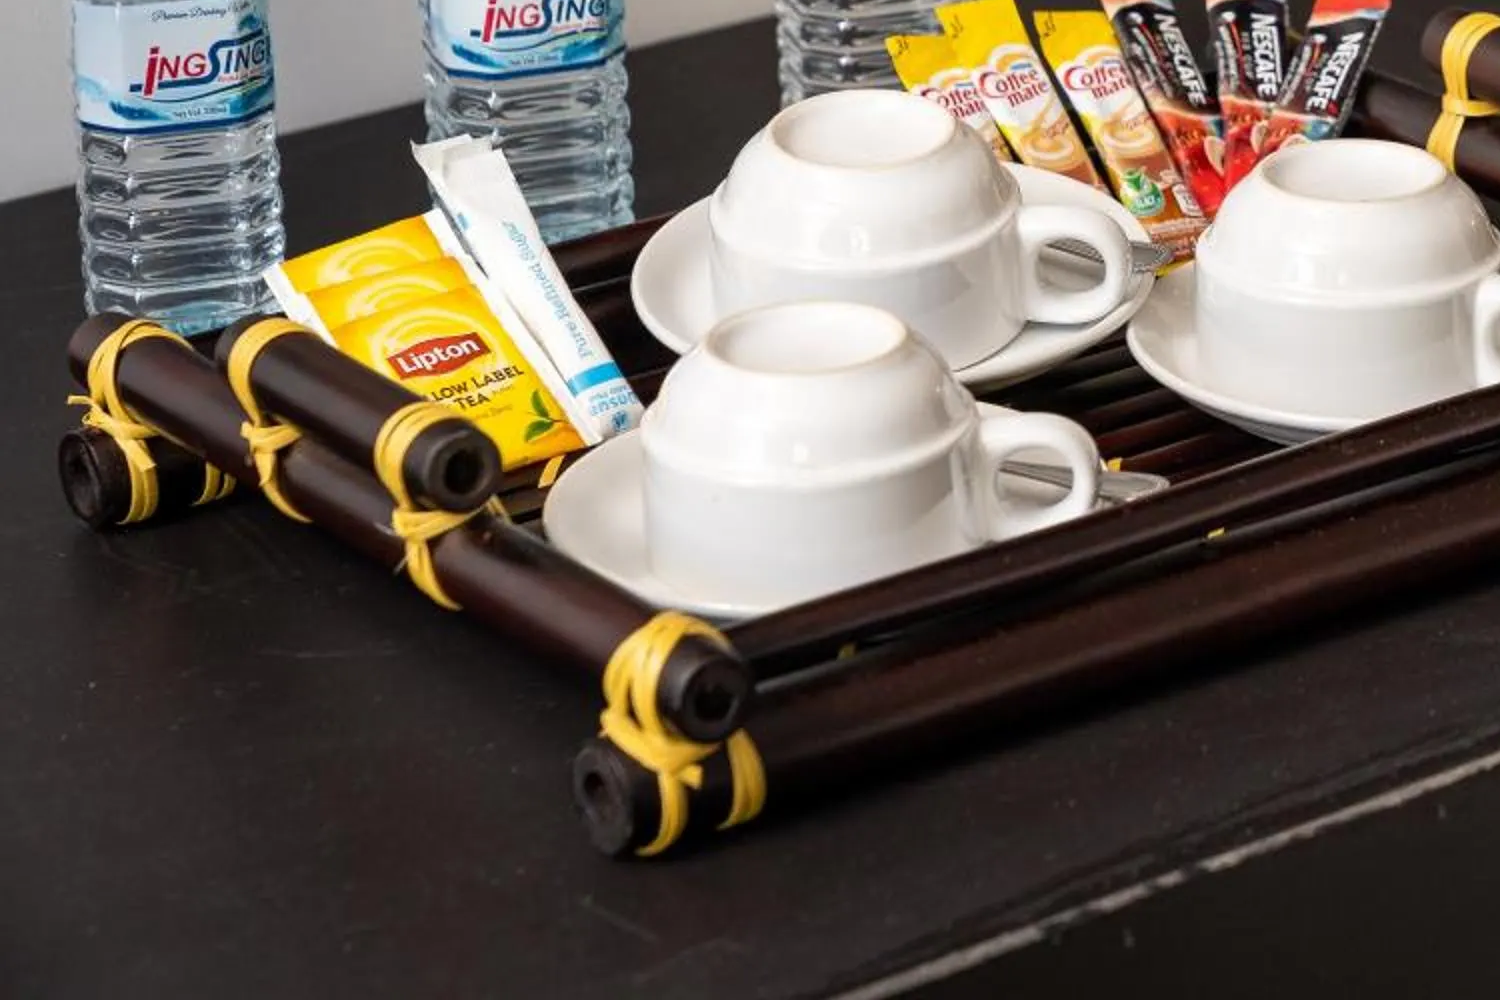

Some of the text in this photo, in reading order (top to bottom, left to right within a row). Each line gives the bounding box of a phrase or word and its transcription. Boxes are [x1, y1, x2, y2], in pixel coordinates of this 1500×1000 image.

[979, 67, 1039, 99] Coffee
[1007, 80, 1049, 108] mate
[398, 339, 480, 373] Lipton
[432, 382, 468, 402] LOW
[471, 365, 524, 389] LABEL
[453, 393, 490, 410] TEA
